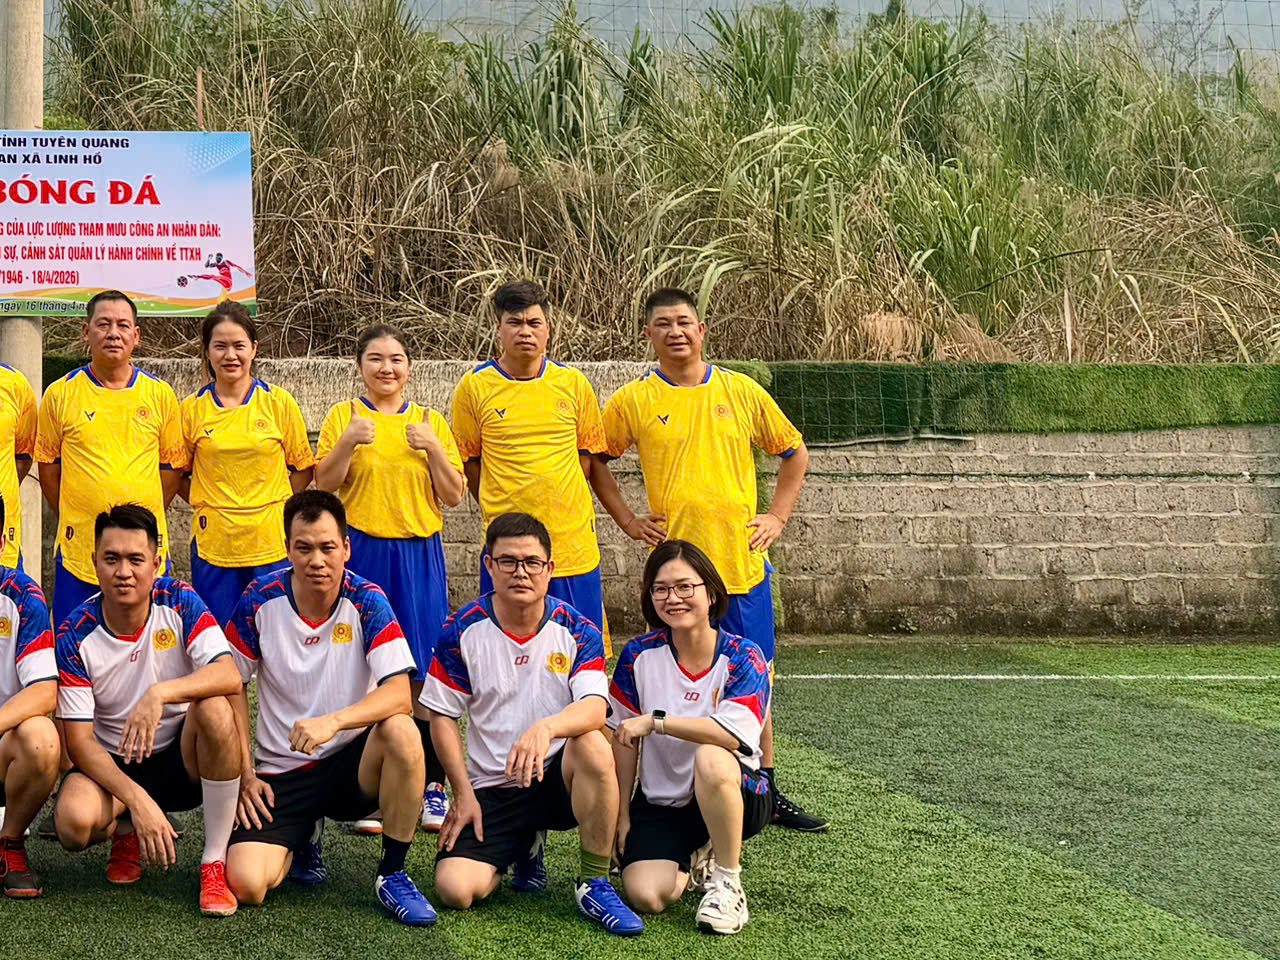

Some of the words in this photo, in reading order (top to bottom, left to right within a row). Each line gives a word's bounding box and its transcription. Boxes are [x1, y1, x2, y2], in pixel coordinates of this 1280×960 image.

[32, 136, 77, 148] TUYÊN
[81, 138, 130, 149] QUANG
[46, 154, 79, 164] LINH
[107, 175, 161, 205] ĐÁ
[6, 217, 25, 236] CỦA
[27, 221, 44, 239] LỰC
[47, 221, 76, 239] LƯỢNG
[78, 222, 104, 236] THAM
[129, 220, 154, 237] CÔNG
[156, 223, 169, 237] AN
[21, 241, 46, 260] CẢNH
[67, 242, 93, 262] QUẢN
[179, 247, 201, 261] TTXH
[31, 270, 80, 286] 18/4/2026)
[26, 301, 37, 311] 16
